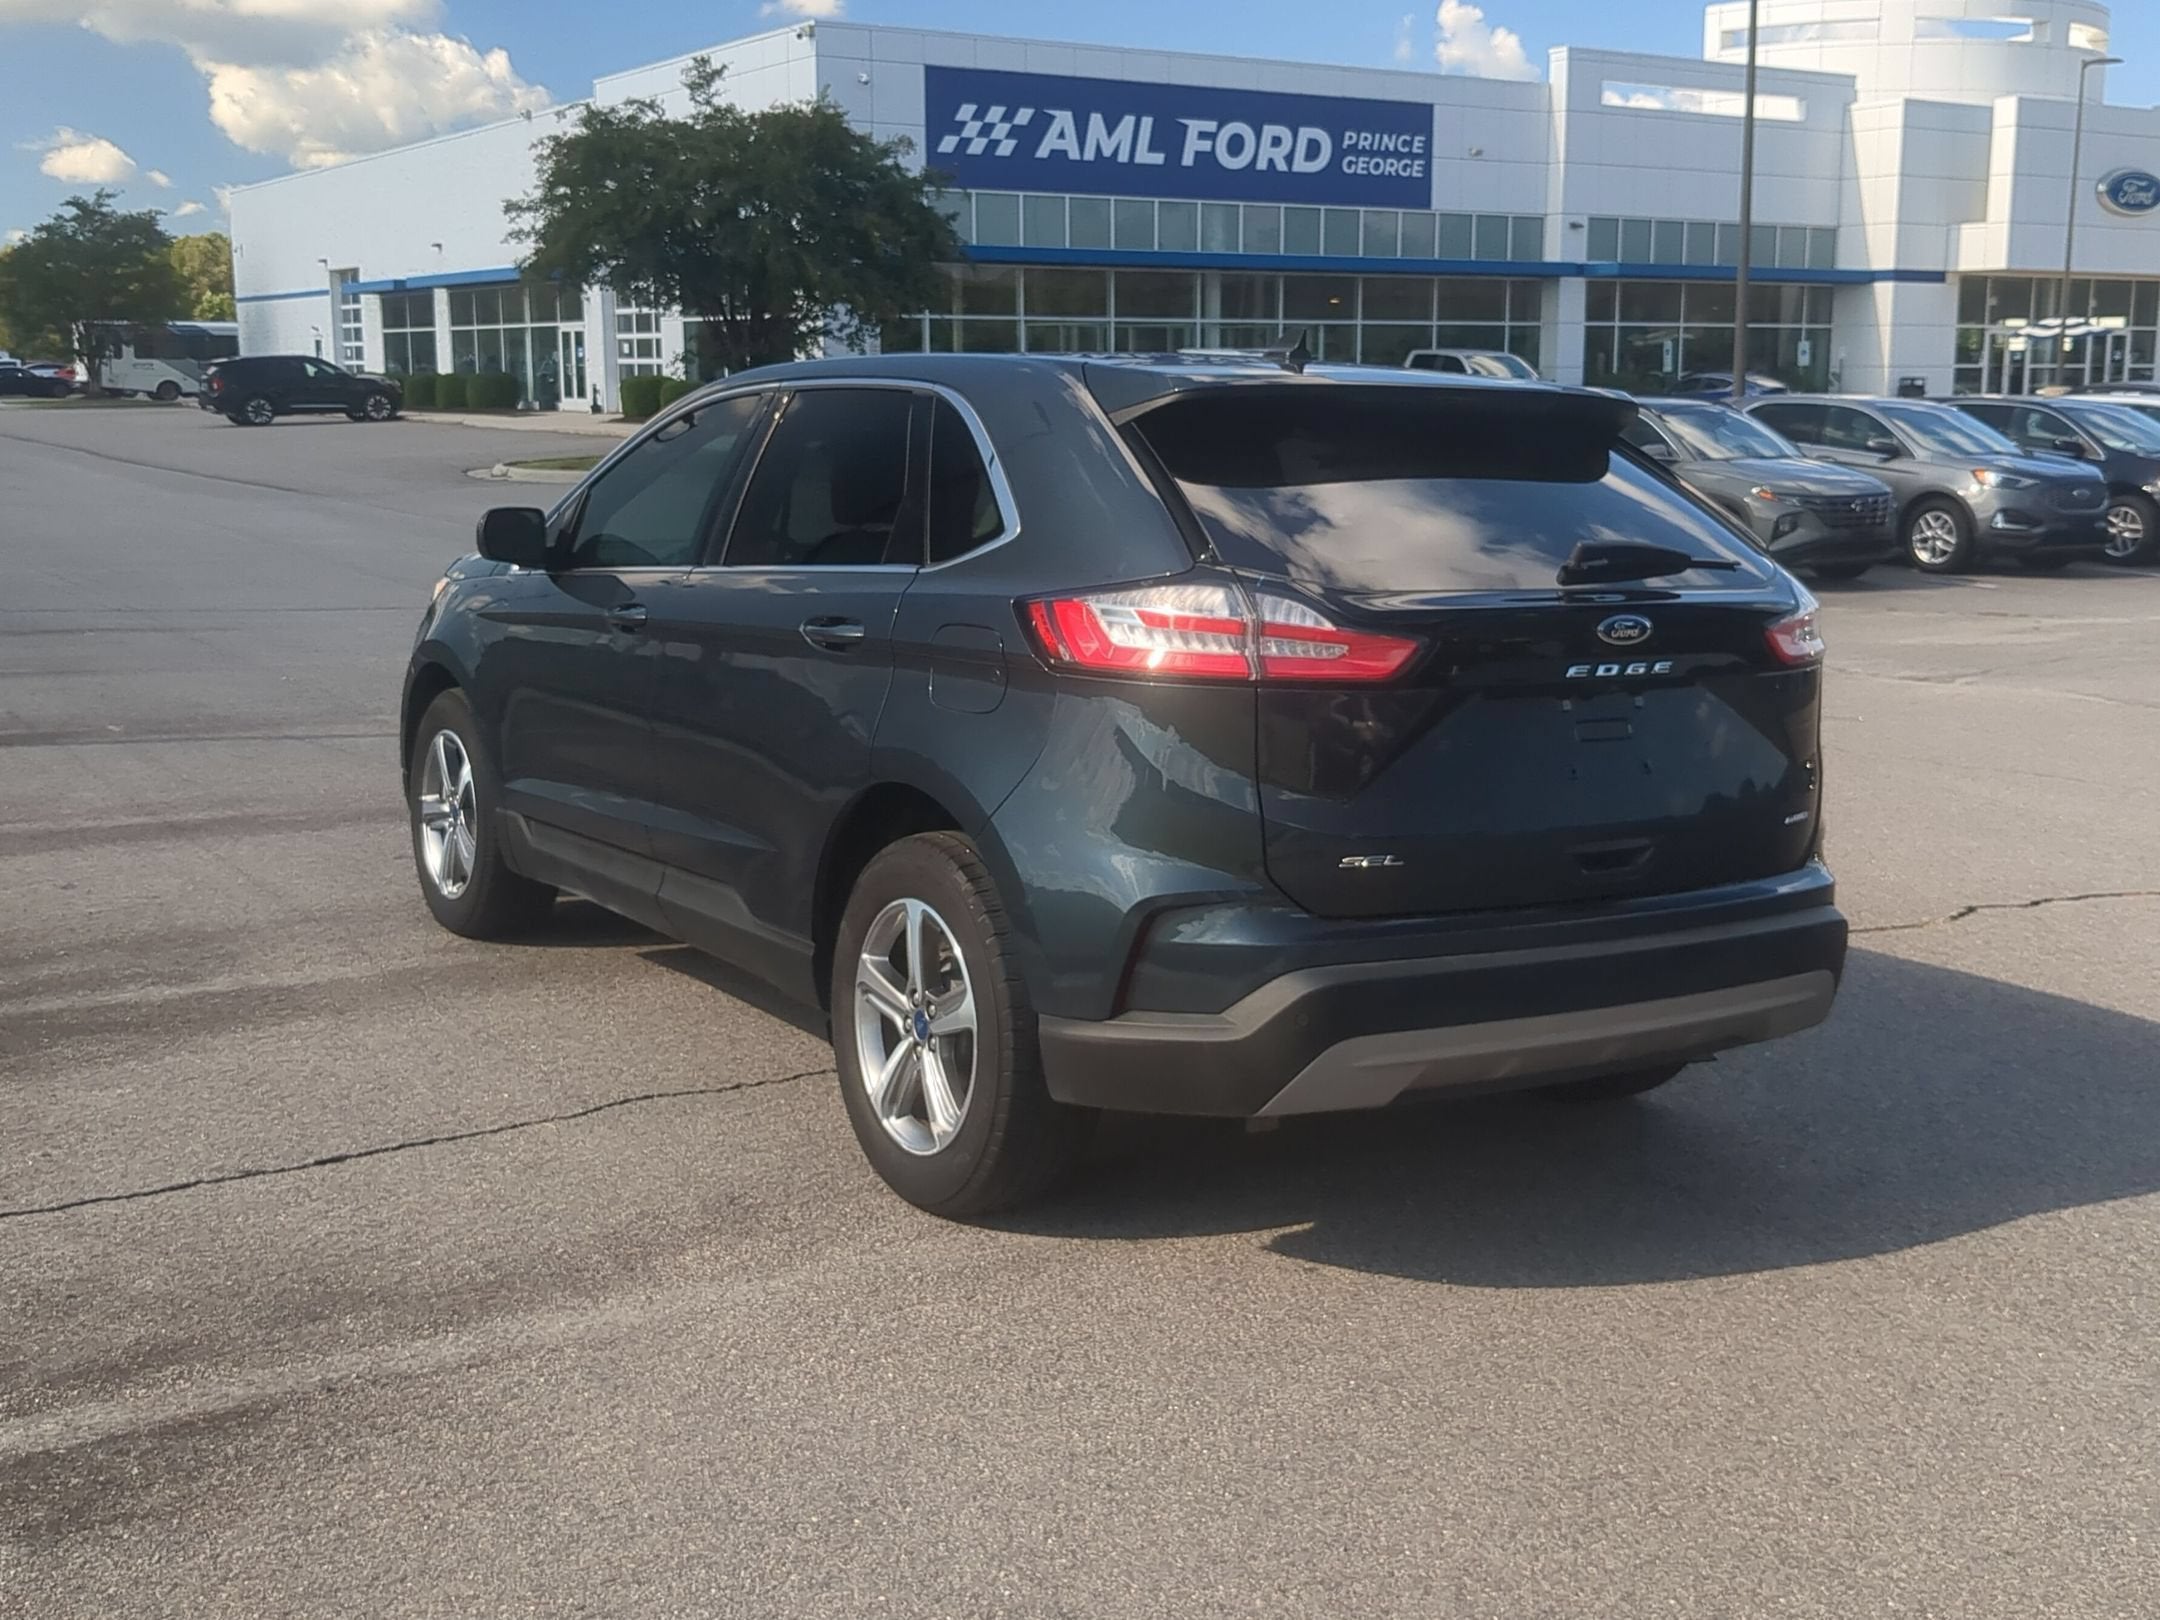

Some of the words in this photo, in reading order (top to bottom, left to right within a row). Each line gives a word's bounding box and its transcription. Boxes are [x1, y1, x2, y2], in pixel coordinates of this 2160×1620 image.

[1034, 109, 1166, 165] AML
[1175, 118, 1333, 174] FORD
[1342, 131, 1426, 154] PRINCE
[1342, 156, 1426, 178] GEORGE
[2118, 178, 2156, 205] Ford
[1611, 620, 1641, 638] Ford
[1565, 661, 1673, 678] EDGE
[1338, 854, 1404, 868] SEL
